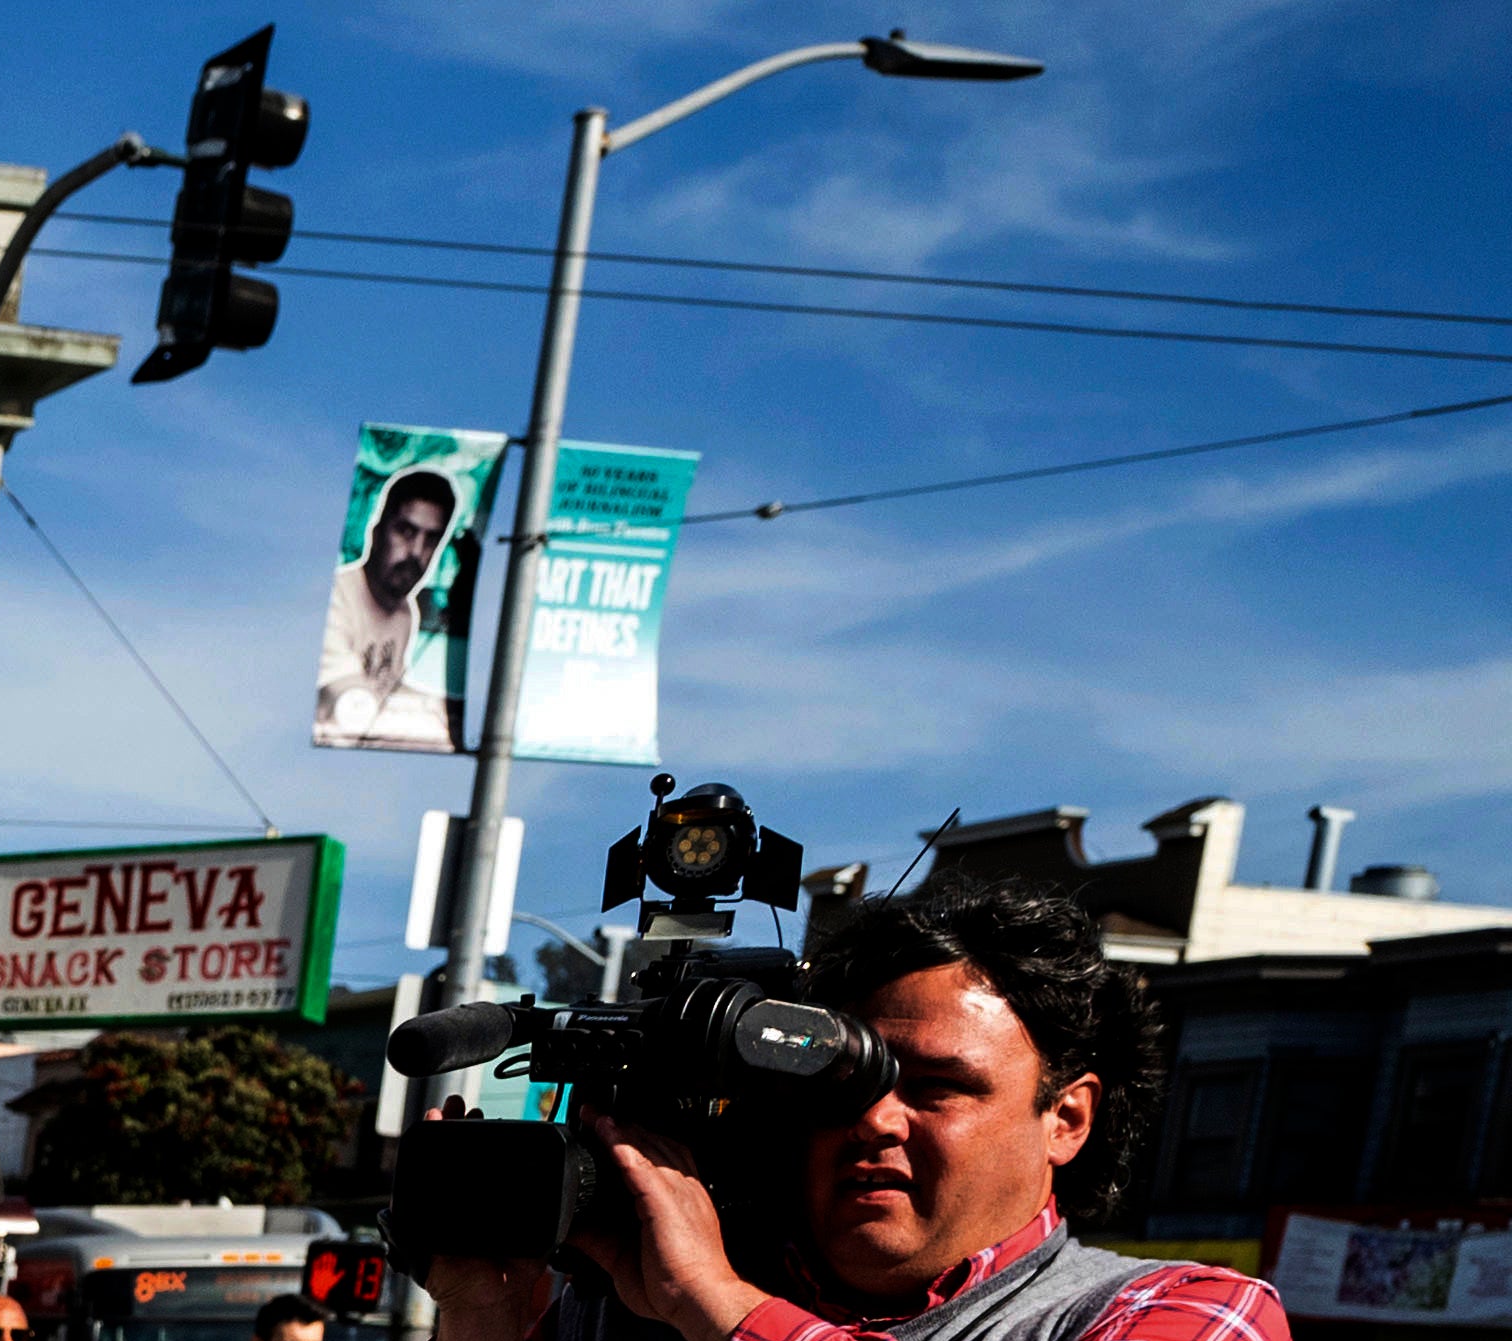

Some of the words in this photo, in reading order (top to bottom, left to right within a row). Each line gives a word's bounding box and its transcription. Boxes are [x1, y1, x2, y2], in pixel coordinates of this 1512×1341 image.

[535, 555, 588, 606] ART
[590, 560, 662, 611] THAT
[530, 606, 640, 657] DEFINES
[10, 861, 266, 938] GENEVA
[138, 938, 292, 984] STORE
[353, 1256, 384, 1301] 13
